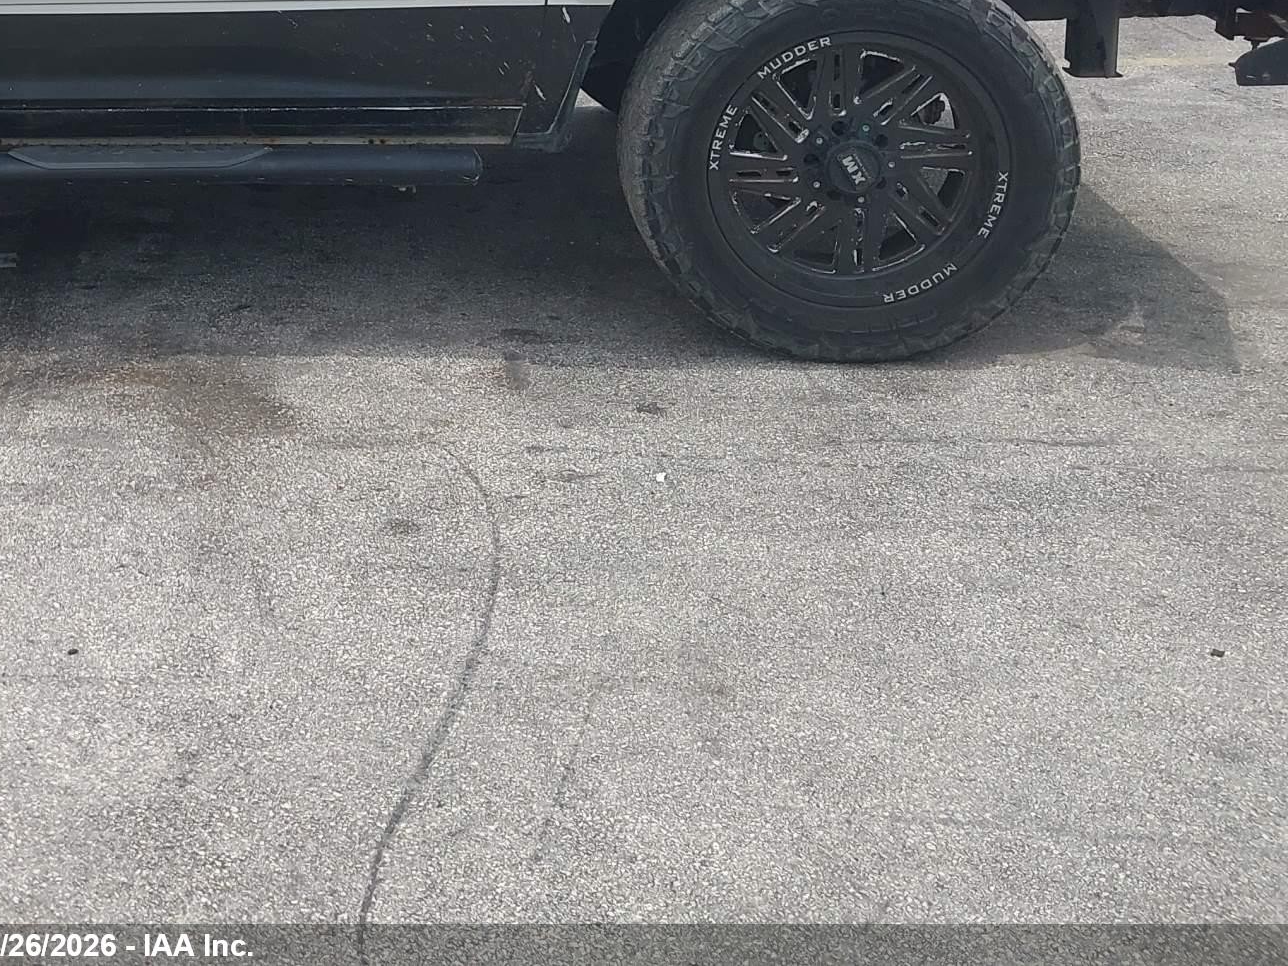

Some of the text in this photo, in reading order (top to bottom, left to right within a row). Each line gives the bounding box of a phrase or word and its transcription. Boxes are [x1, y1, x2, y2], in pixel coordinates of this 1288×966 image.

[709, 37, 832, 170] XTREME MUDDER
[883, 171, 1009, 304] XTREME MUDDER
